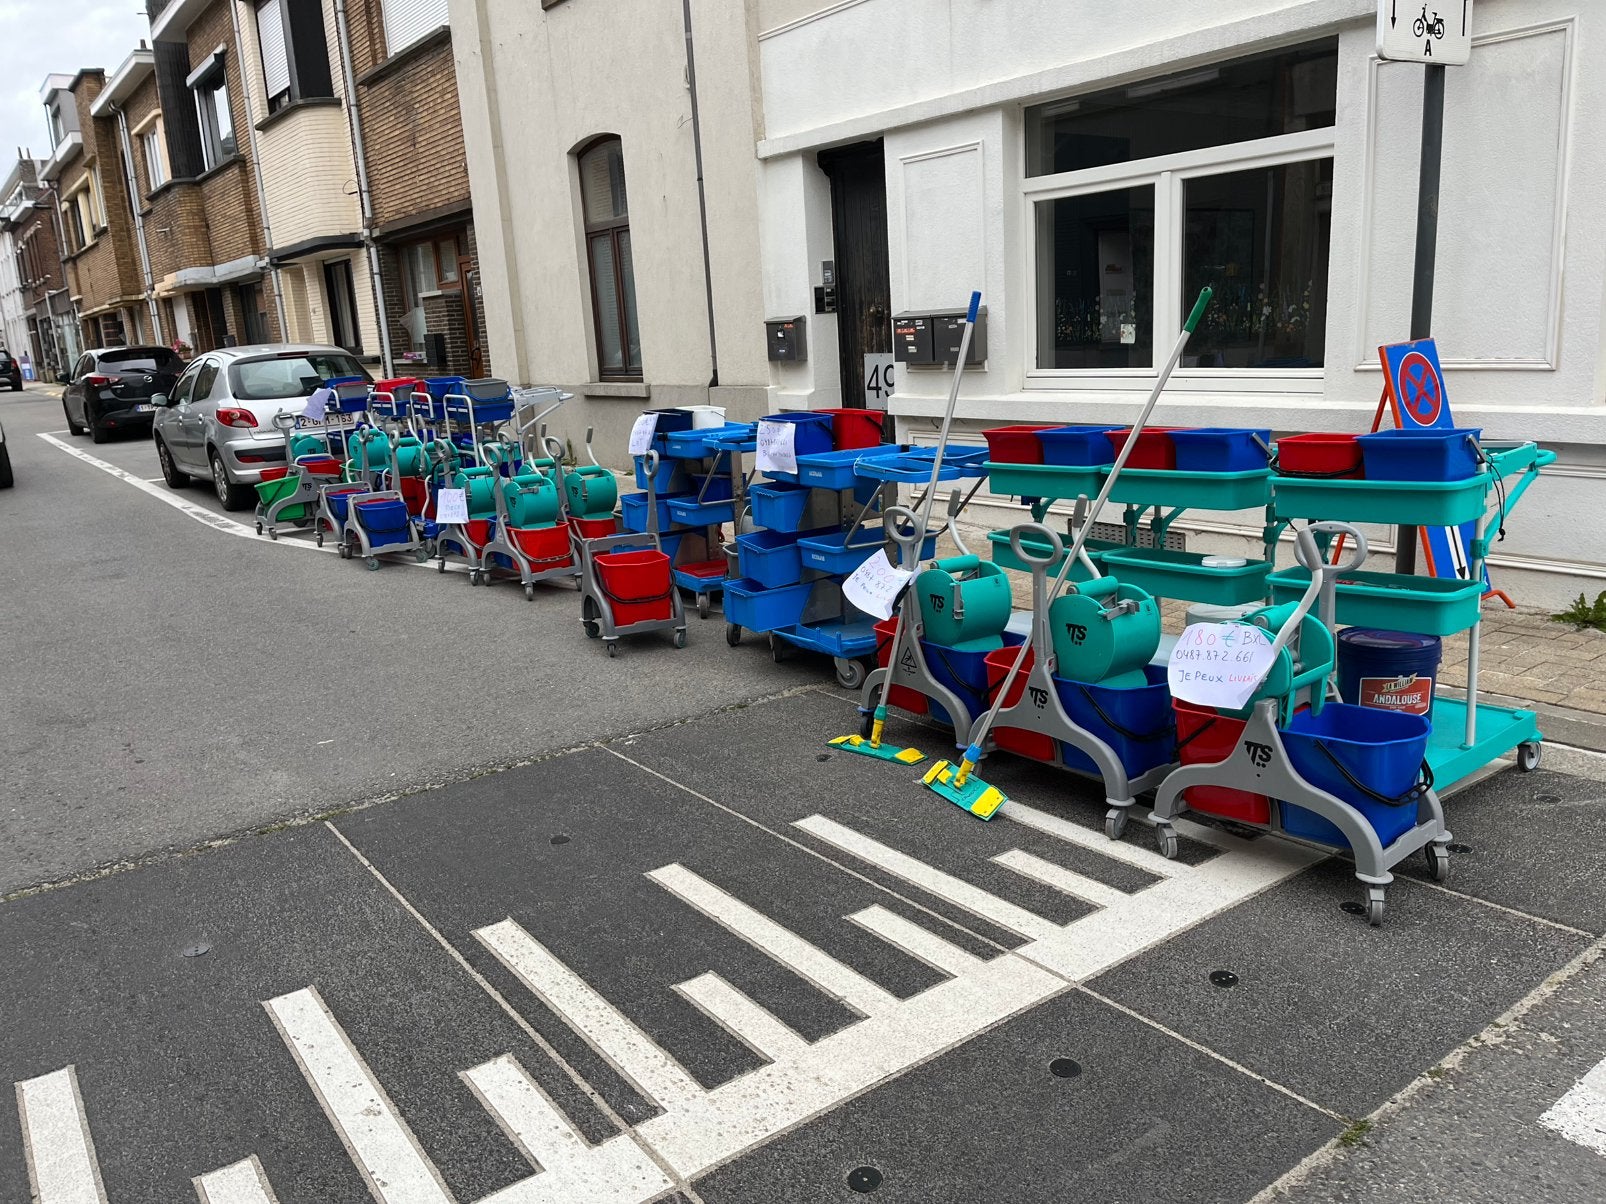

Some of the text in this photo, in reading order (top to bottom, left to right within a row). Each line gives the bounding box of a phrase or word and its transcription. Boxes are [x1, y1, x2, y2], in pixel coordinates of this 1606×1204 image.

[1424, 39, 1432, 56] A
[867, 364, 894, 398] 49
[930, 594, 945, 611] TTS
[1066, 624, 1087, 644] TTS
[1182, 629, 1216, 646] 180
[1220, 630, 1235, 647] €
[1178, 670, 1191, 682] JE
[1029, 686, 1048, 707] TTS
[1373, 694, 1422, 705] ANDALOUSE
[1244, 741, 1273, 766] TTS
